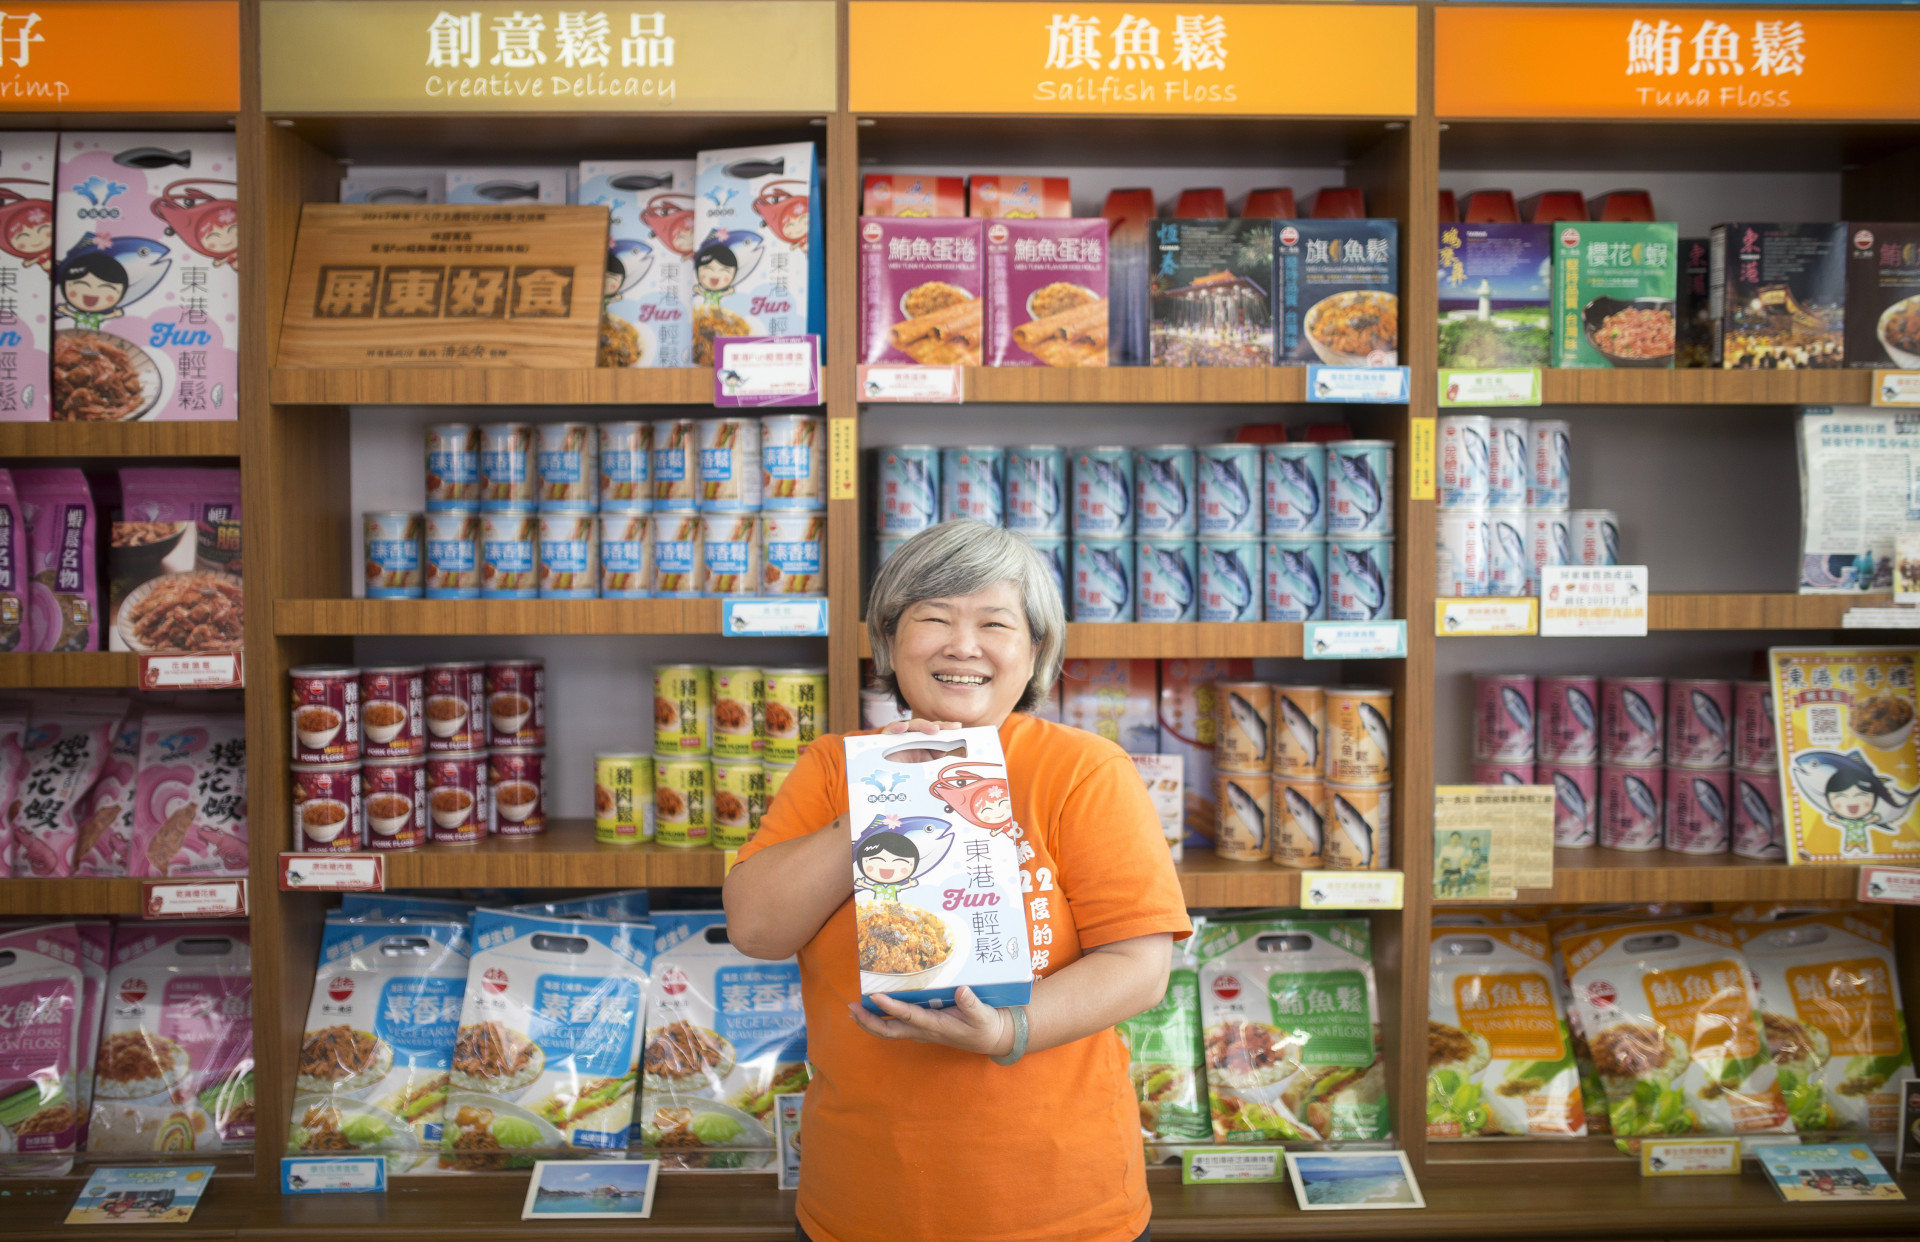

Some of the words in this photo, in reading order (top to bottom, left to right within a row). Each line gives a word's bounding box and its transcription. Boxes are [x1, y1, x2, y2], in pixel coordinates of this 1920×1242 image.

[426, 11, 675, 68] 創意鬆品
[1044, 13, 1228, 71] 旗魚鬆
[1625, 19, 1806, 76] 鮪魚鬆
[425, 72, 543, 97] Creative
[551, 72, 676, 100] Delicacy
[1033, 76, 1154, 104] Sailfish
[1165, 79, 1237, 102] Floss
[1635, 87, 1709, 107] Tuna
[1719, 85, 1791, 107] Floss
[889, 237, 976, 262] 鮪魚蛋捲
[1014, 238, 1102, 263] 鮪魚蛋捲
[1305, 238, 1389, 264] 旗魚鬆
[1587, 242, 1668, 267] 櫻花蝦
[660, 262, 680, 306] 東港
[769, 252, 789, 298] 東港
[179, 266, 209, 325] 東港
[316, 266, 572, 318] 屏東好食
[750, 296, 791, 315] Fun
[638, 304, 682, 323] Fun
[768, 316, 788, 336] 輕
[150, 322, 211, 348] Fun
[178, 351, 208, 411] 輕鬆
[681, 679, 697, 735] 豬肉鬆
[799, 684, 815, 742] 豬肉鬆
[24, 735, 89, 829] 櫻花蝦
[199, 738, 246, 825] 櫻花蝦
[616, 768, 633, 823] 豬肉鬆
[688, 769, 704, 825] 豬肉鬆
[963, 839, 995, 889] 東港
[942, 888, 1000, 911] Fun
[972, 911, 1004, 963] 輕鬆
[165, 990, 253, 1019] 三文魚
[540, 993, 629, 1025] 素香鬆
[1277, 986, 1363, 1015] 鮪魚鬆
[1460, 981, 1550, 1010] 鮪魚鬆
[1332, 1025, 1366, 1039] FLOSS
[1473, 1019, 1514, 1032] TUNA
[1516, 1018, 1555, 1032] FLOSS
[22, 1037, 61, 1050] FLOSS
